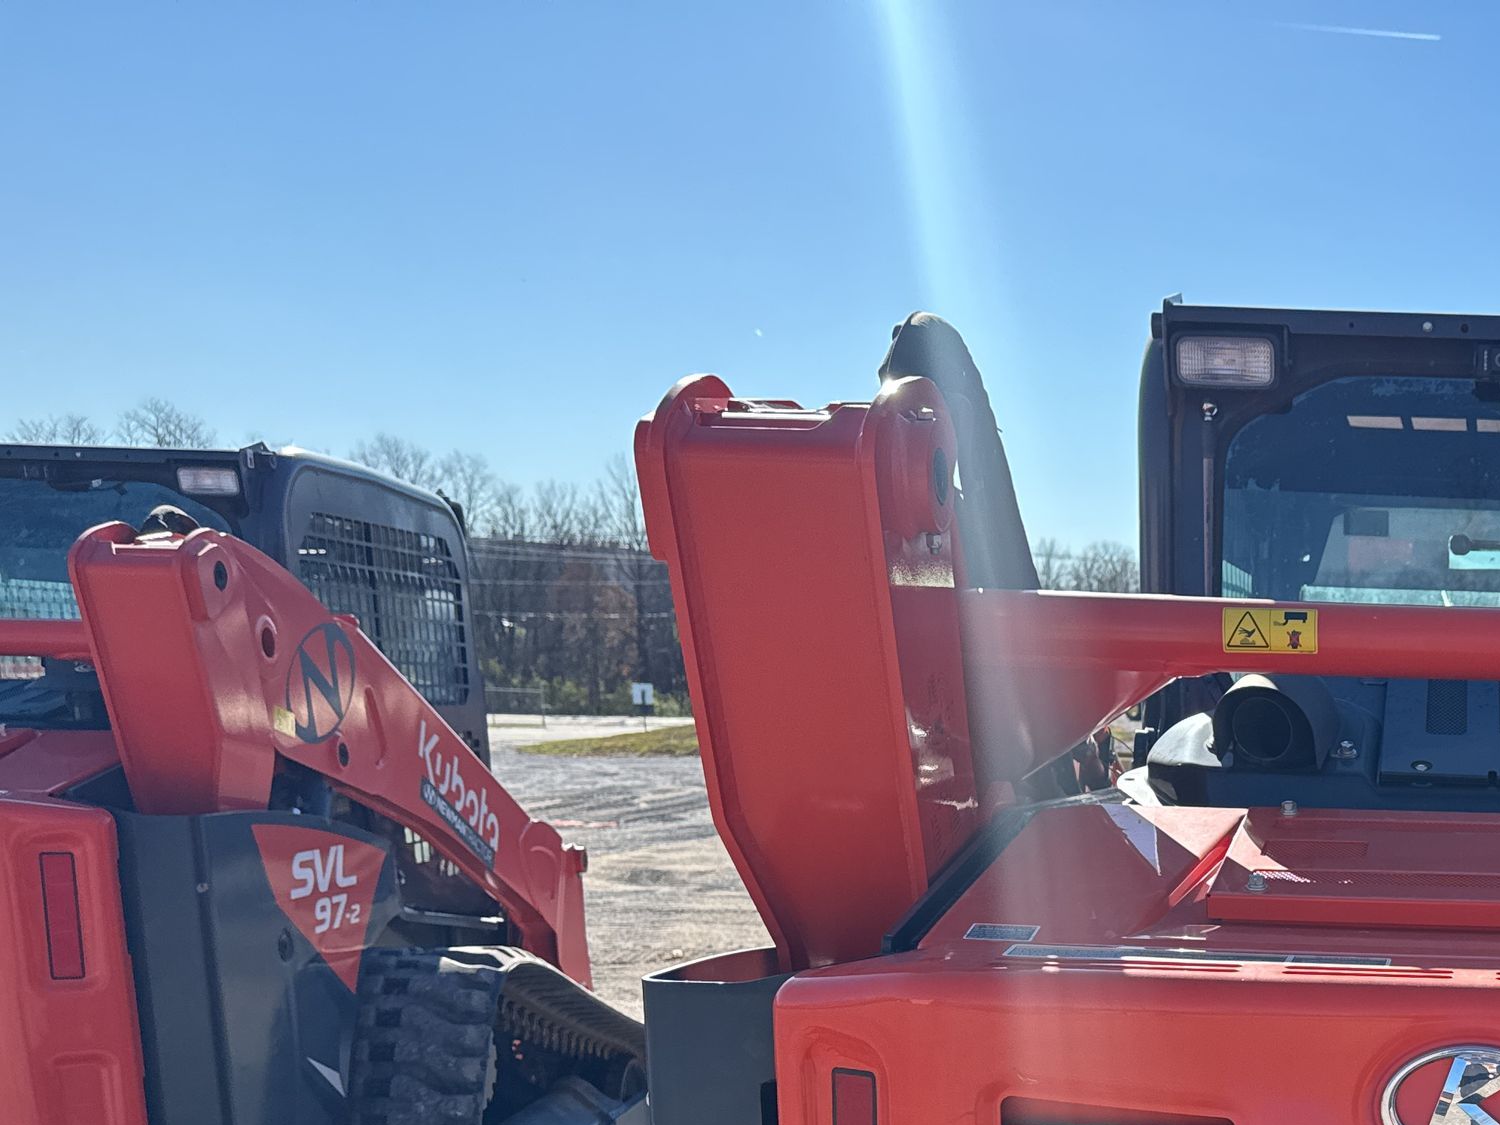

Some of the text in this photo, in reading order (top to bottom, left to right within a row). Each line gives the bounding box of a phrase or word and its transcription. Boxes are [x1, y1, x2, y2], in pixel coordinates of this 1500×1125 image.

[418, 719, 499, 852] Kubota
[290, 844, 357, 900] SVL
[314, 893, 361, 935] 97-2
